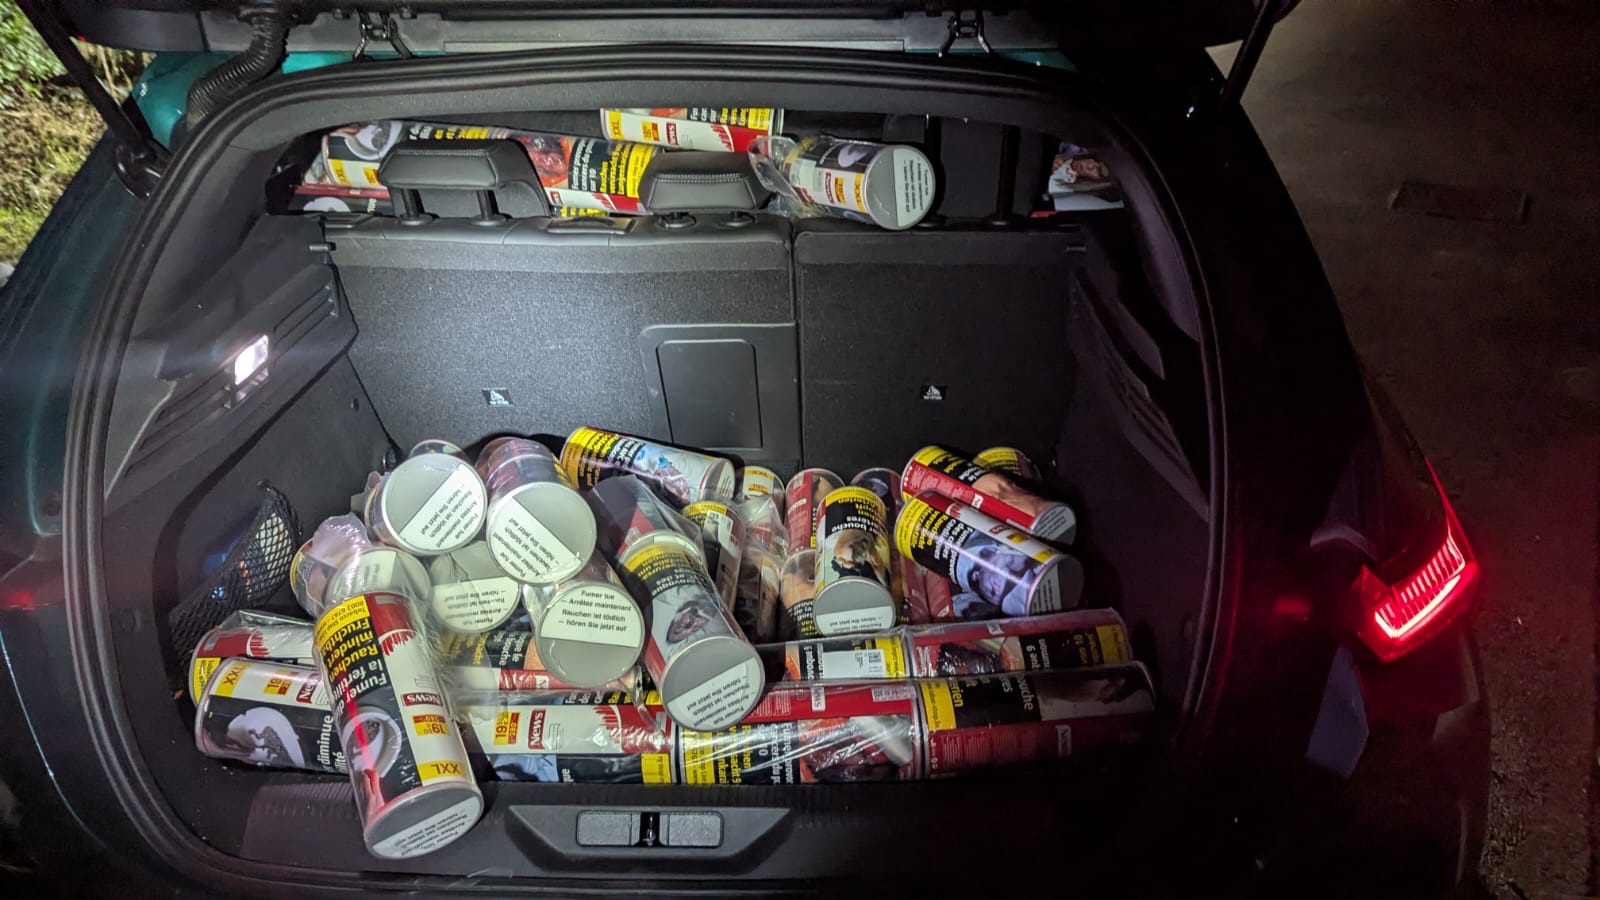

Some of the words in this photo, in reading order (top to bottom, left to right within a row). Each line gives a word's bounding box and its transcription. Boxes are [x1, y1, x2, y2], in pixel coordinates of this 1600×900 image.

[450, 489, 472, 513] Rauchen
[437, 503, 448, 514] Sie
[426, 511, 440, 525] jetzt
[444, 512, 453, 520] ist
[461, 512, 479, 531] Fumer
[508, 517, 519, 528] auf
[419, 523, 430, 534] auf
[428, 519, 447, 538] tödlich
[434, 518, 462, 548] maintenant
[453, 529, 464, 539] tue
[516, 524, 532, 539] jetzt
[831, 522, 866, 532] bouche
[951, 521, 964, 537] des
[503, 526, 522, 544] tödlich
[528, 536, 539, 547] Sie
[492, 531, 522, 560] maintenant
[521, 542, 530, 551] ist
[537, 544, 555, 561] hören
[499, 551, 510, 562] tue
[507, 559, 526, 577] Fumer
[520, 557, 540, 577] Arrêtez
[655, 574, 673, 587] des
[581, 589, 602, 598] Fumer
[568, 597, 593, 607] Arrêtez
[594, 601, 631, 611] maintenant
[339, 607, 365, 621] Tobacco
[561, 608, 591, 617] Rauchen
[602, 612, 625, 622] tödlich
[566, 619, 586, 627] hören
[599, 622, 614, 631] jetzt
[325, 630, 373, 667] mindert
[327, 643, 378, 682] Rauchen
[511, 652, 522, 663] le
[367, 659, 383, 671] la
[345, 672, 387, 701] Fumer
[721, 677, 741, 691] hören
[406, 693, 439, 702] News
[696, 692, 711, 704] jetzt
[710, 687, 722, 697] Sie
[685, 701, 697, 710] auf
[713, 696, 723, 705] ist
[691, 701, 714, 716] tödlich
[692, 704, 727, 727] maintenant
[723, 704, 744, 719] Fumer
[712, 716, 723, 725] tue
[431, 723, 443, 734] 19
[495, 724, 507, 738] 19
[529, 711, 543, 746] News
[316, 714, 333, 764] diminue
[781, 722, 792, 754] Fume
[431, 762, 460, 775] XXL
[771, 764, 781, 775] du
